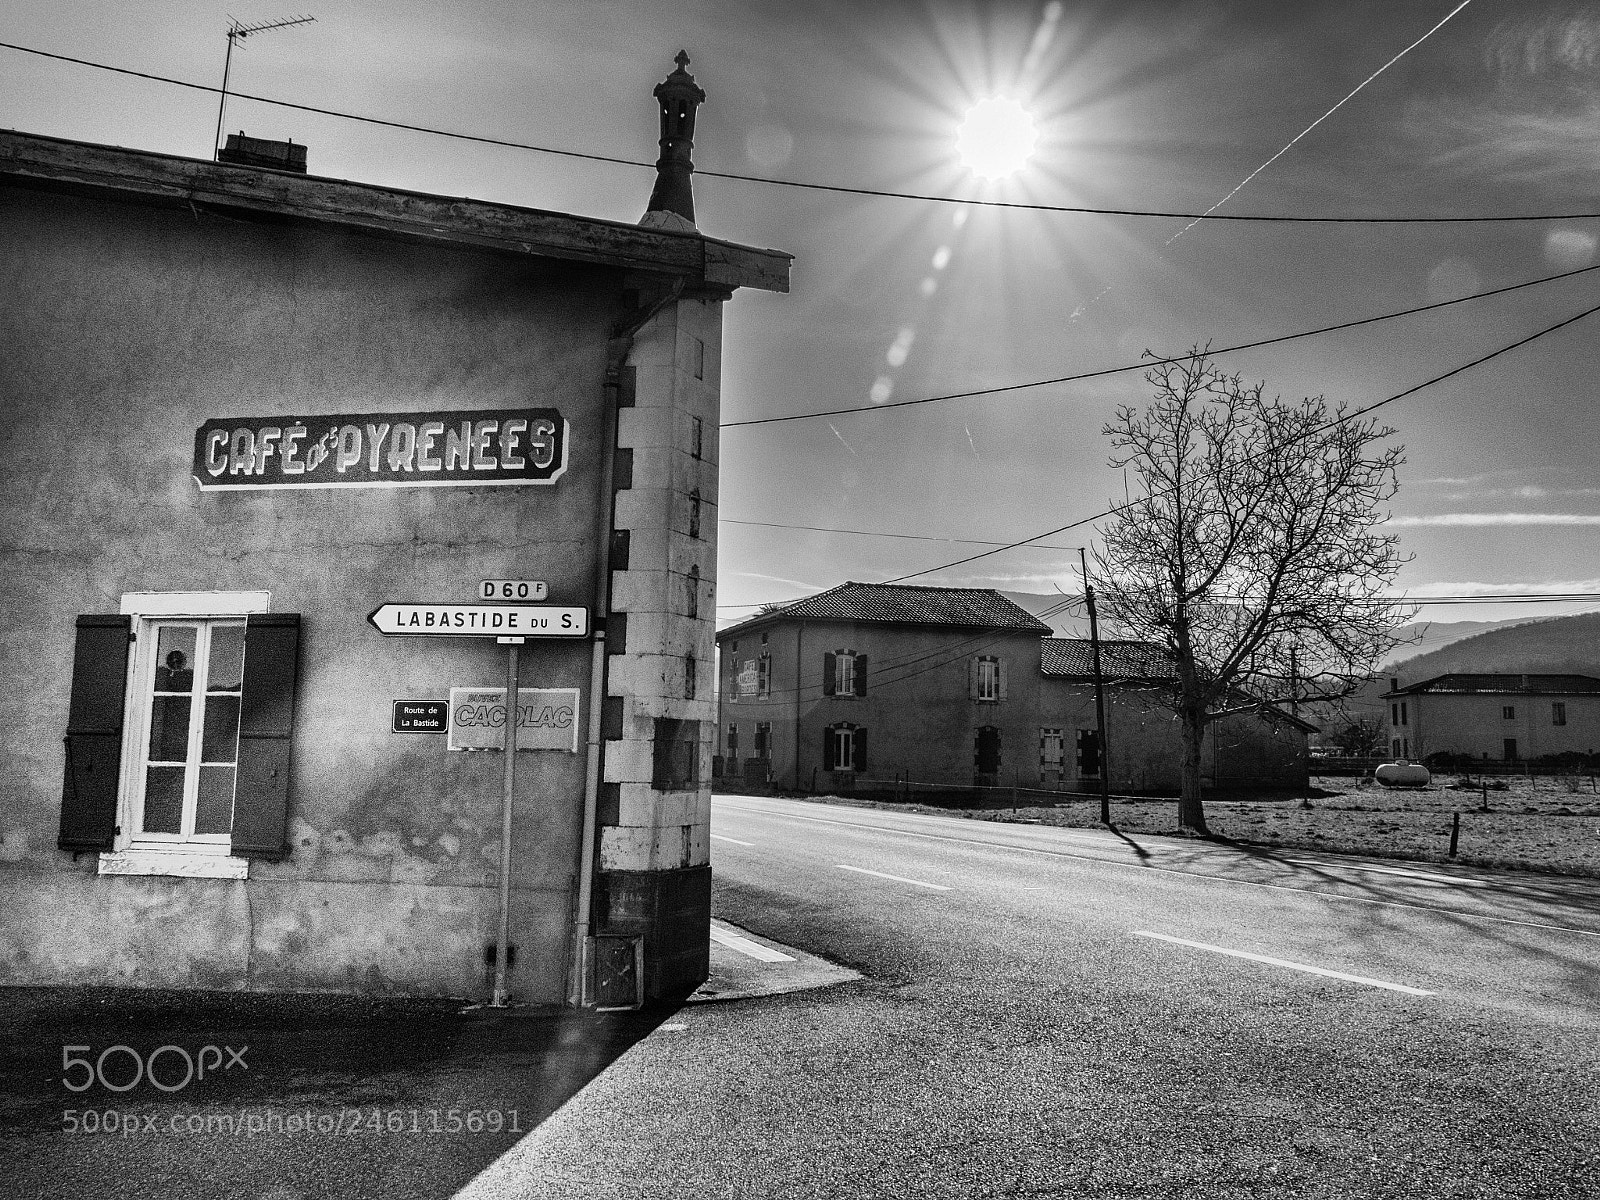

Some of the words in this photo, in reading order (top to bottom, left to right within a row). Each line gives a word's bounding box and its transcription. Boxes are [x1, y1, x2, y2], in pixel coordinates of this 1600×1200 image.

[336, 418, 556, 473] PYRENEES
[397, 611, 519, 628] LABASTIDE
[531, 618, 548, 628] DU
[561, 613, 580, 629] S.
[404, 706, 425, 714] Route
[428, 706, 438, 714] de
[401, 719, 410, 727] La
[413, 718, 439, 727] Bastide
